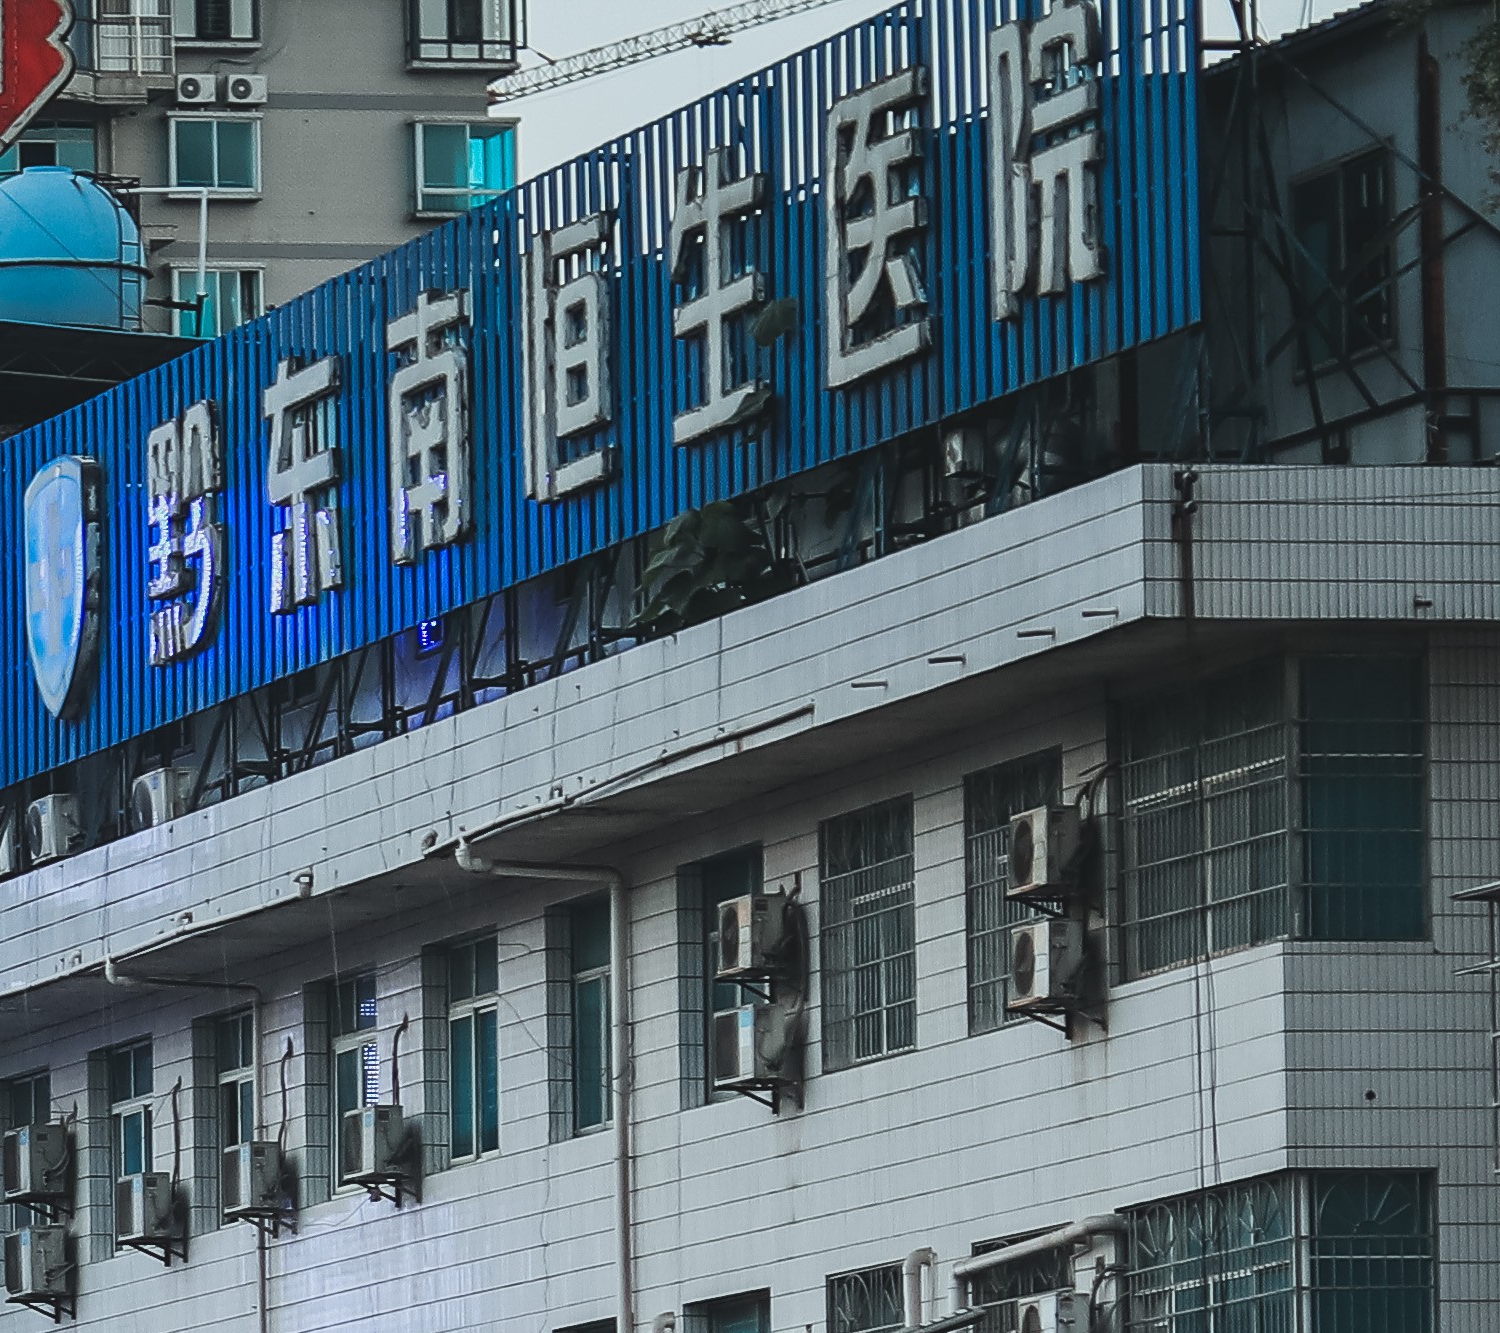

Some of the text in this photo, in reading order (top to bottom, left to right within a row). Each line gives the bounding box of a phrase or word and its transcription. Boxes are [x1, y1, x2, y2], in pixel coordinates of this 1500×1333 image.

[145, 0, 1104, 668] 黔东南恒生医院
